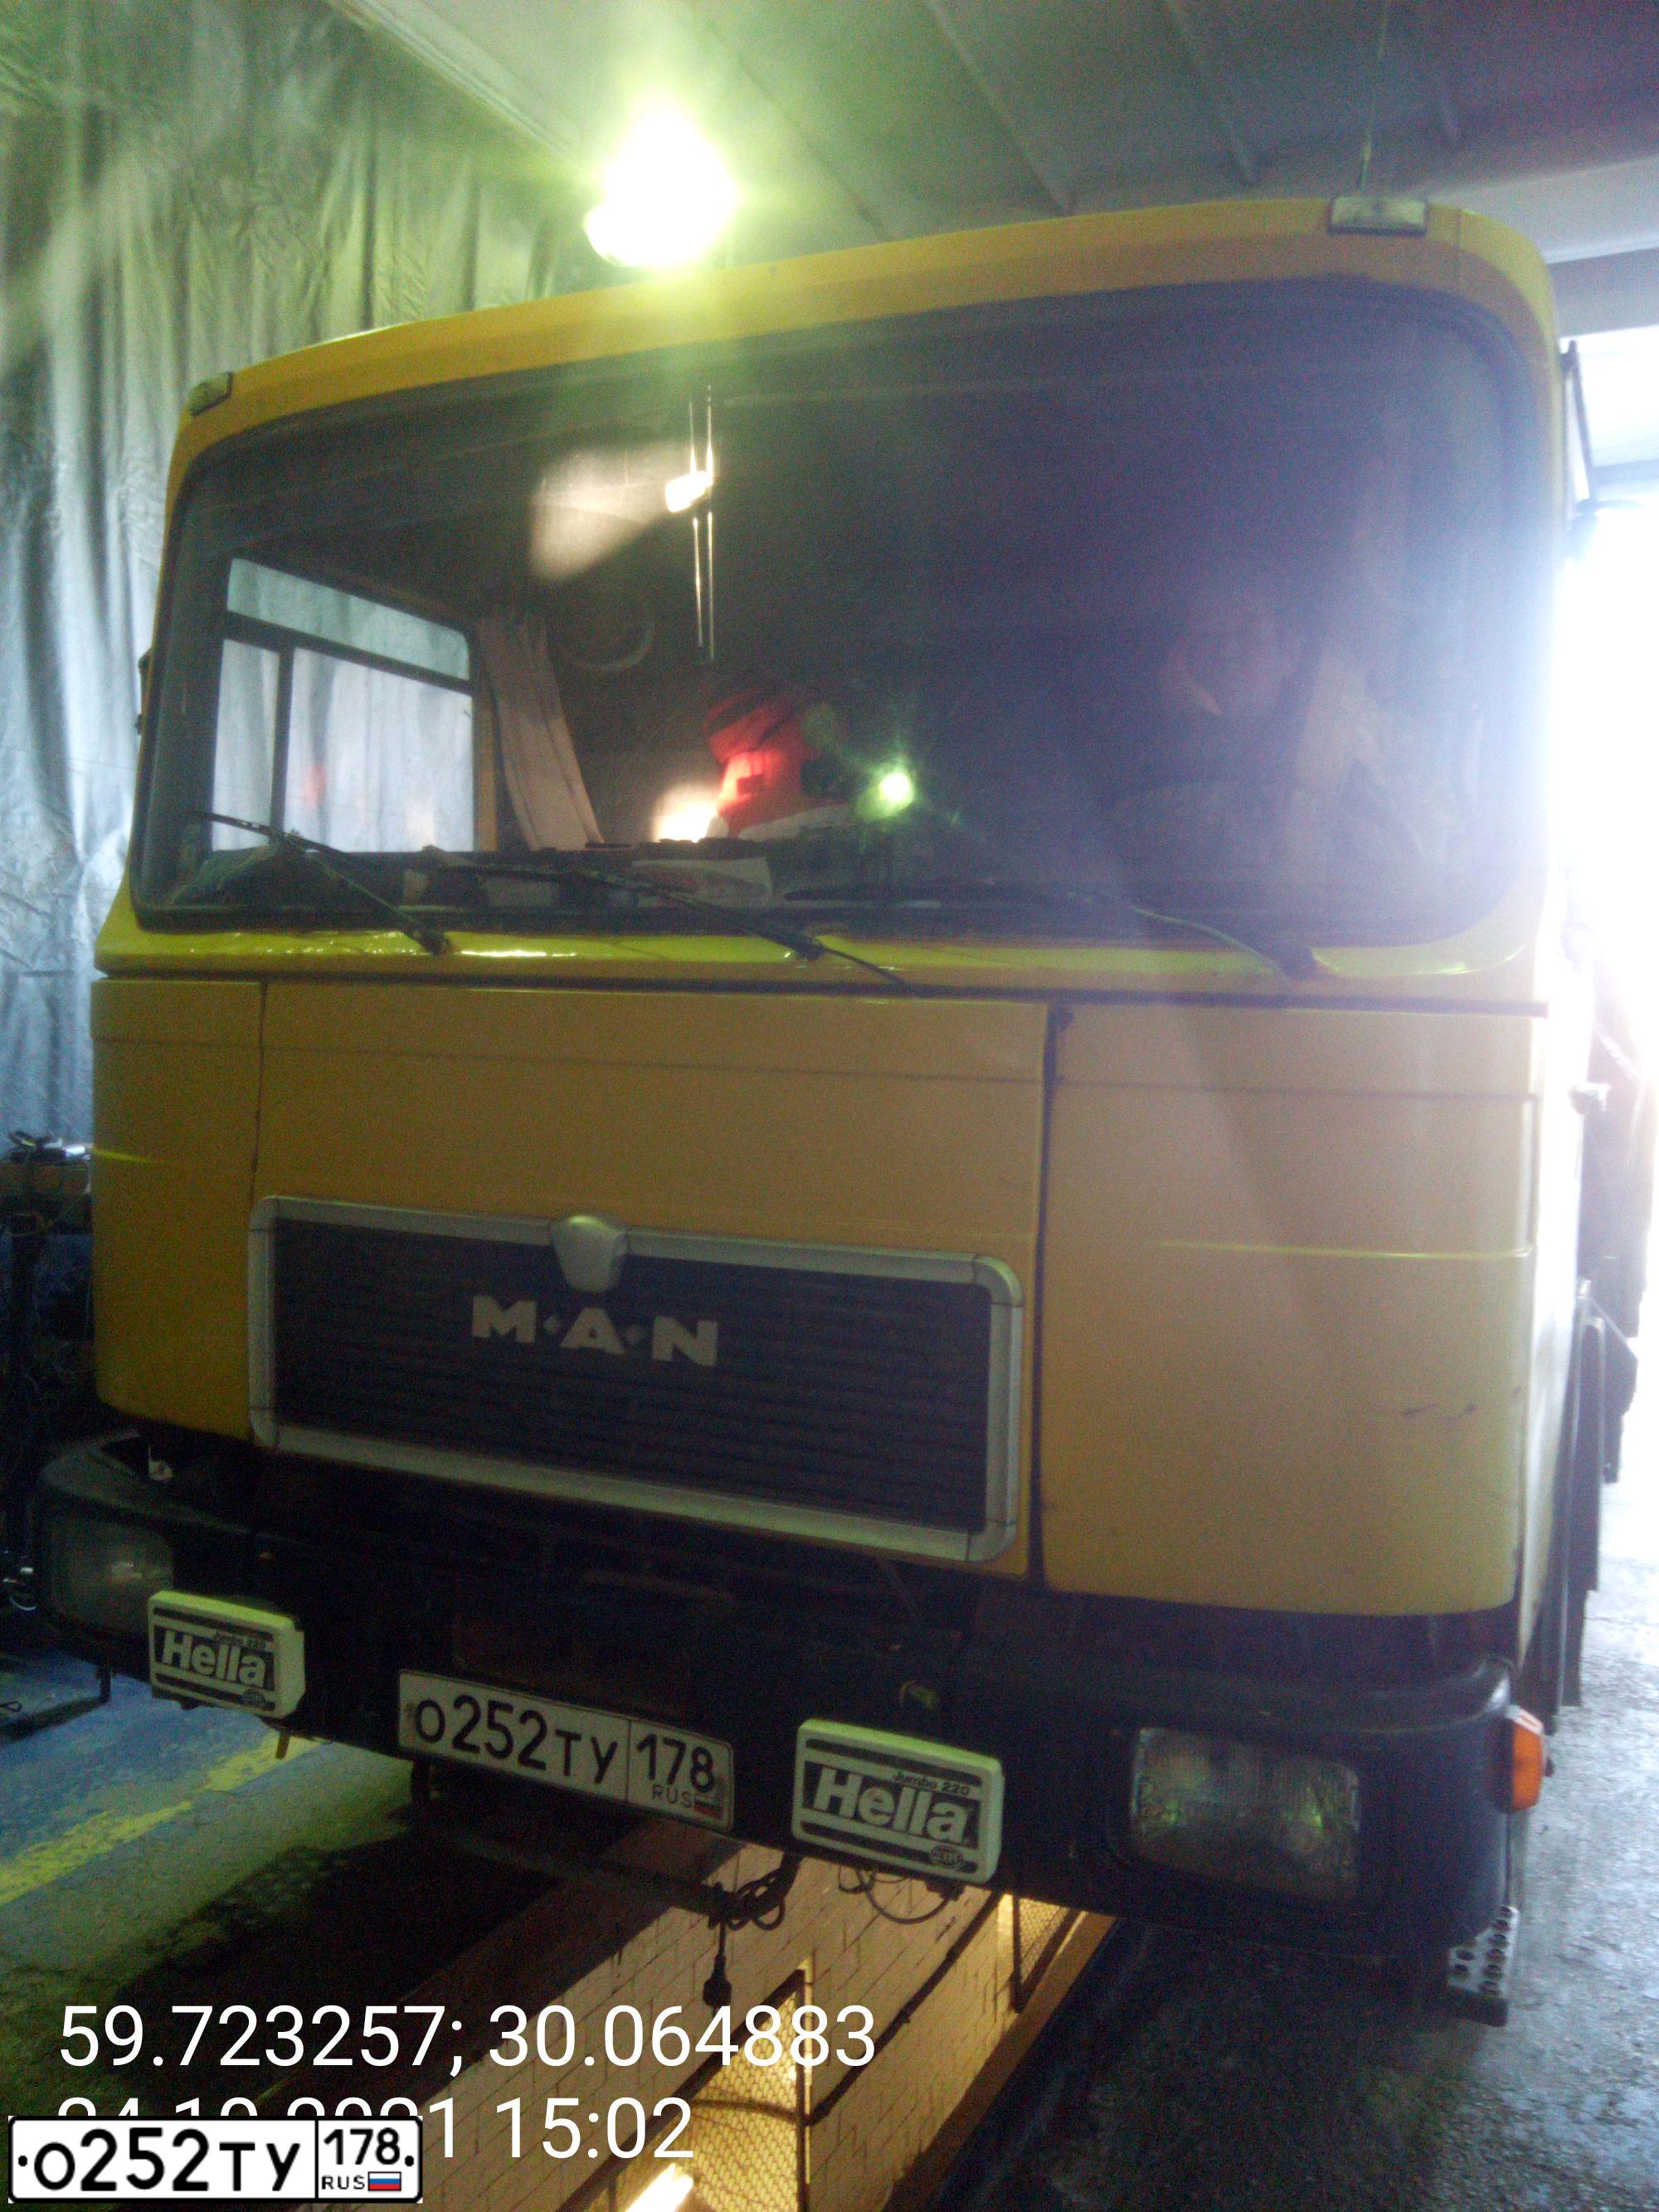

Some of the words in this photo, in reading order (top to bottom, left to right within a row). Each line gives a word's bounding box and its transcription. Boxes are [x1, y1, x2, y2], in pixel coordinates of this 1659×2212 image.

[162, 1629, 267, 1688] Hella
[637, 1733, 715, 1793] 178
[652, 1784, 695, 1809] RUS
[813, 1766, 971, 1844] Hella
